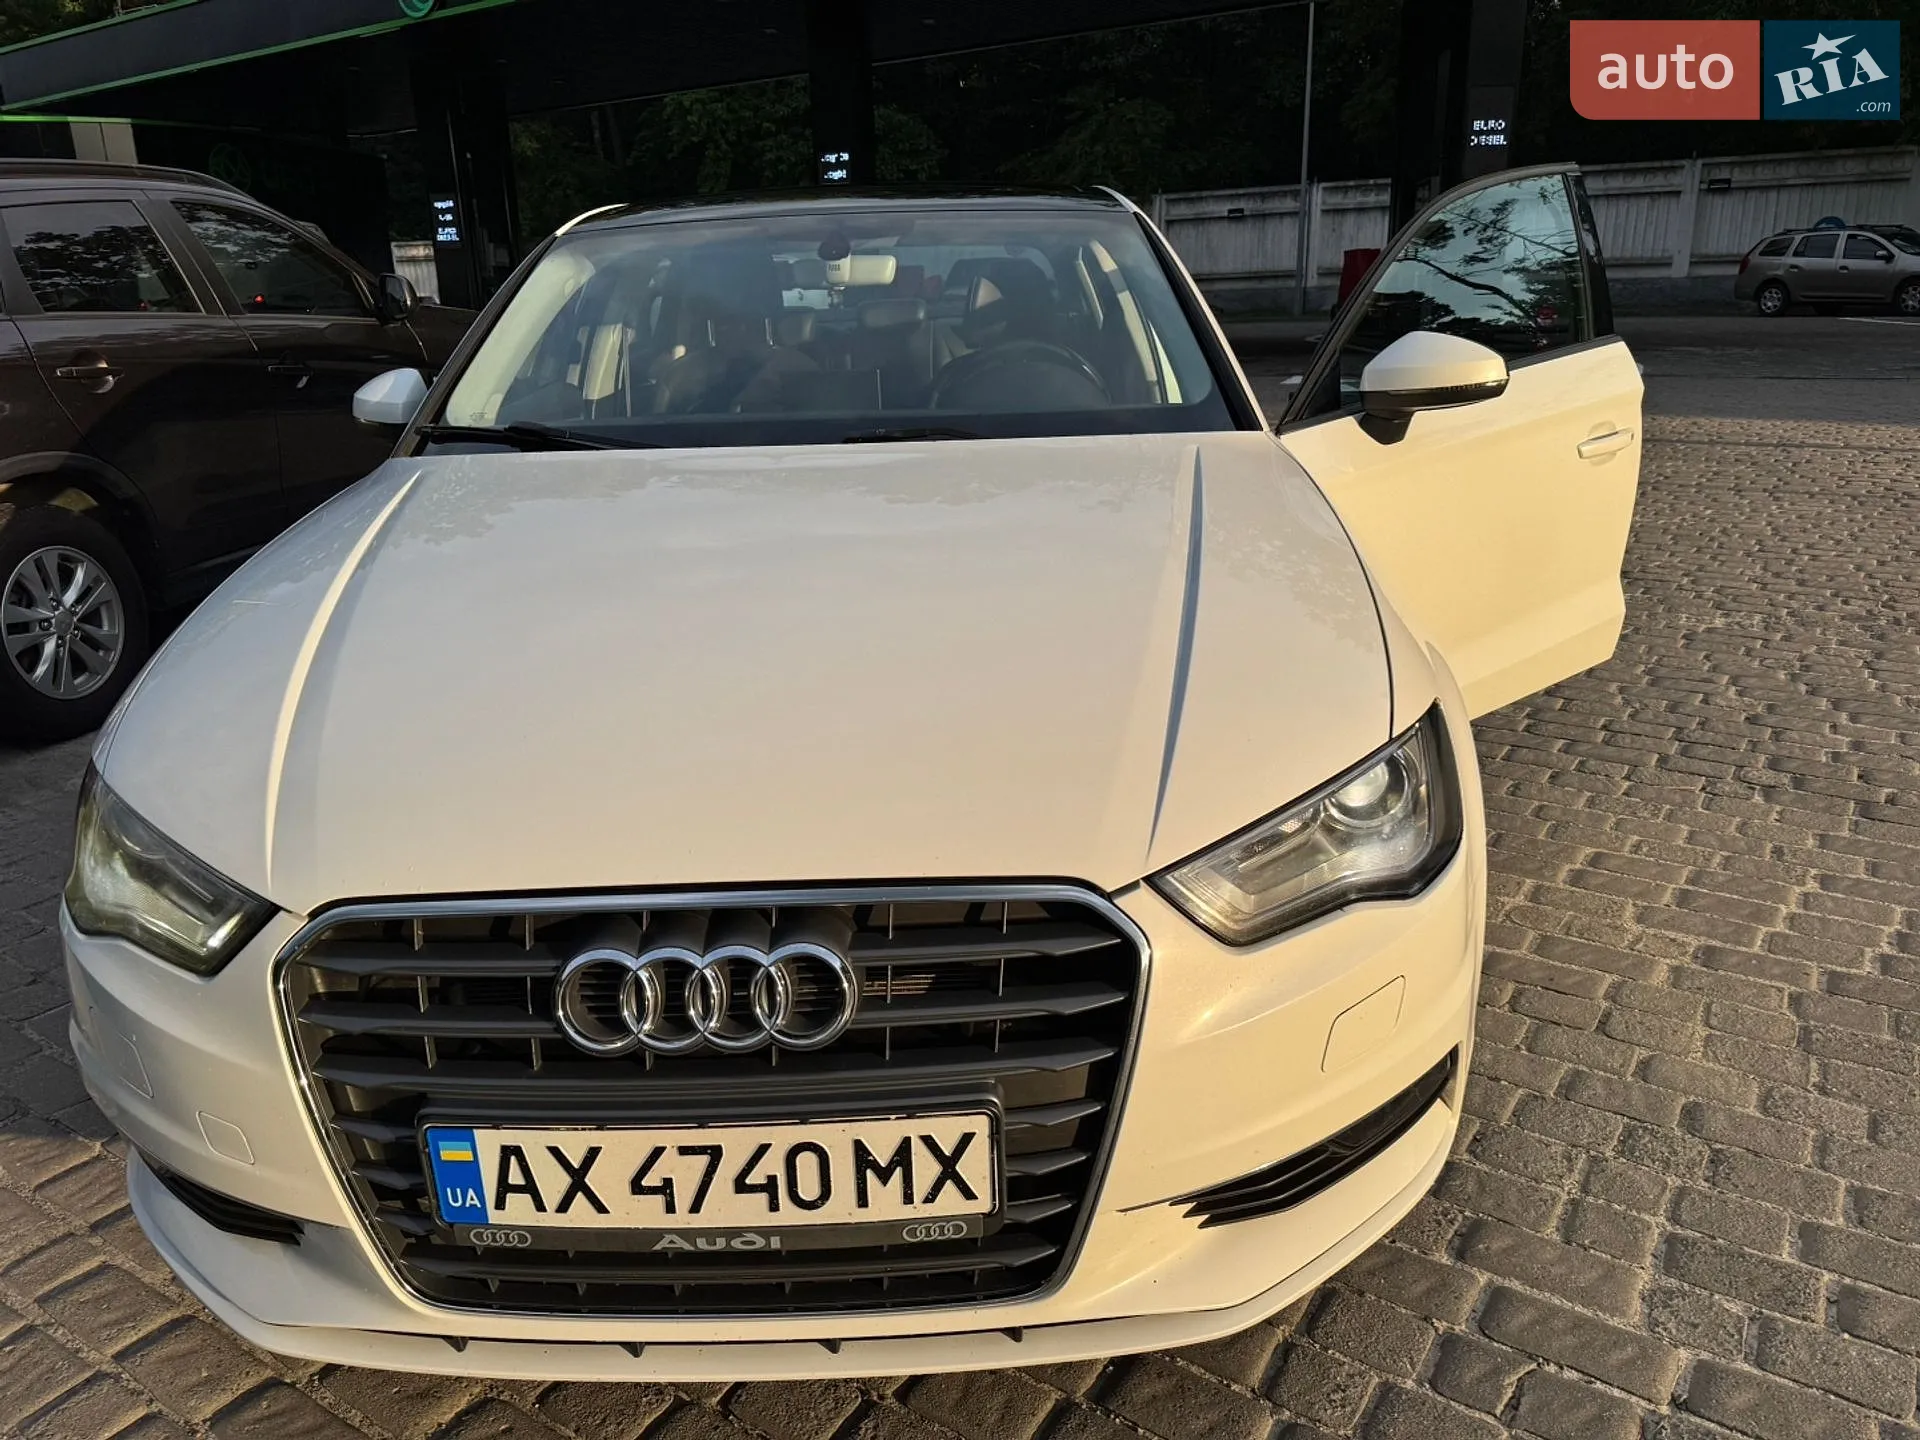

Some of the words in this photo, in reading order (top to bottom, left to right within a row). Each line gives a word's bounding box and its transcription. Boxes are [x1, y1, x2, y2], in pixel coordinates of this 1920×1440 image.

[493, 1144, 611, 1215] AX
[629, 1142, 831, 1215] 4740
[853, 1131, 979, 1209] MX
[447, 1187, 481, 1209] UA
[651, 1233, 780, 1252] Audi
